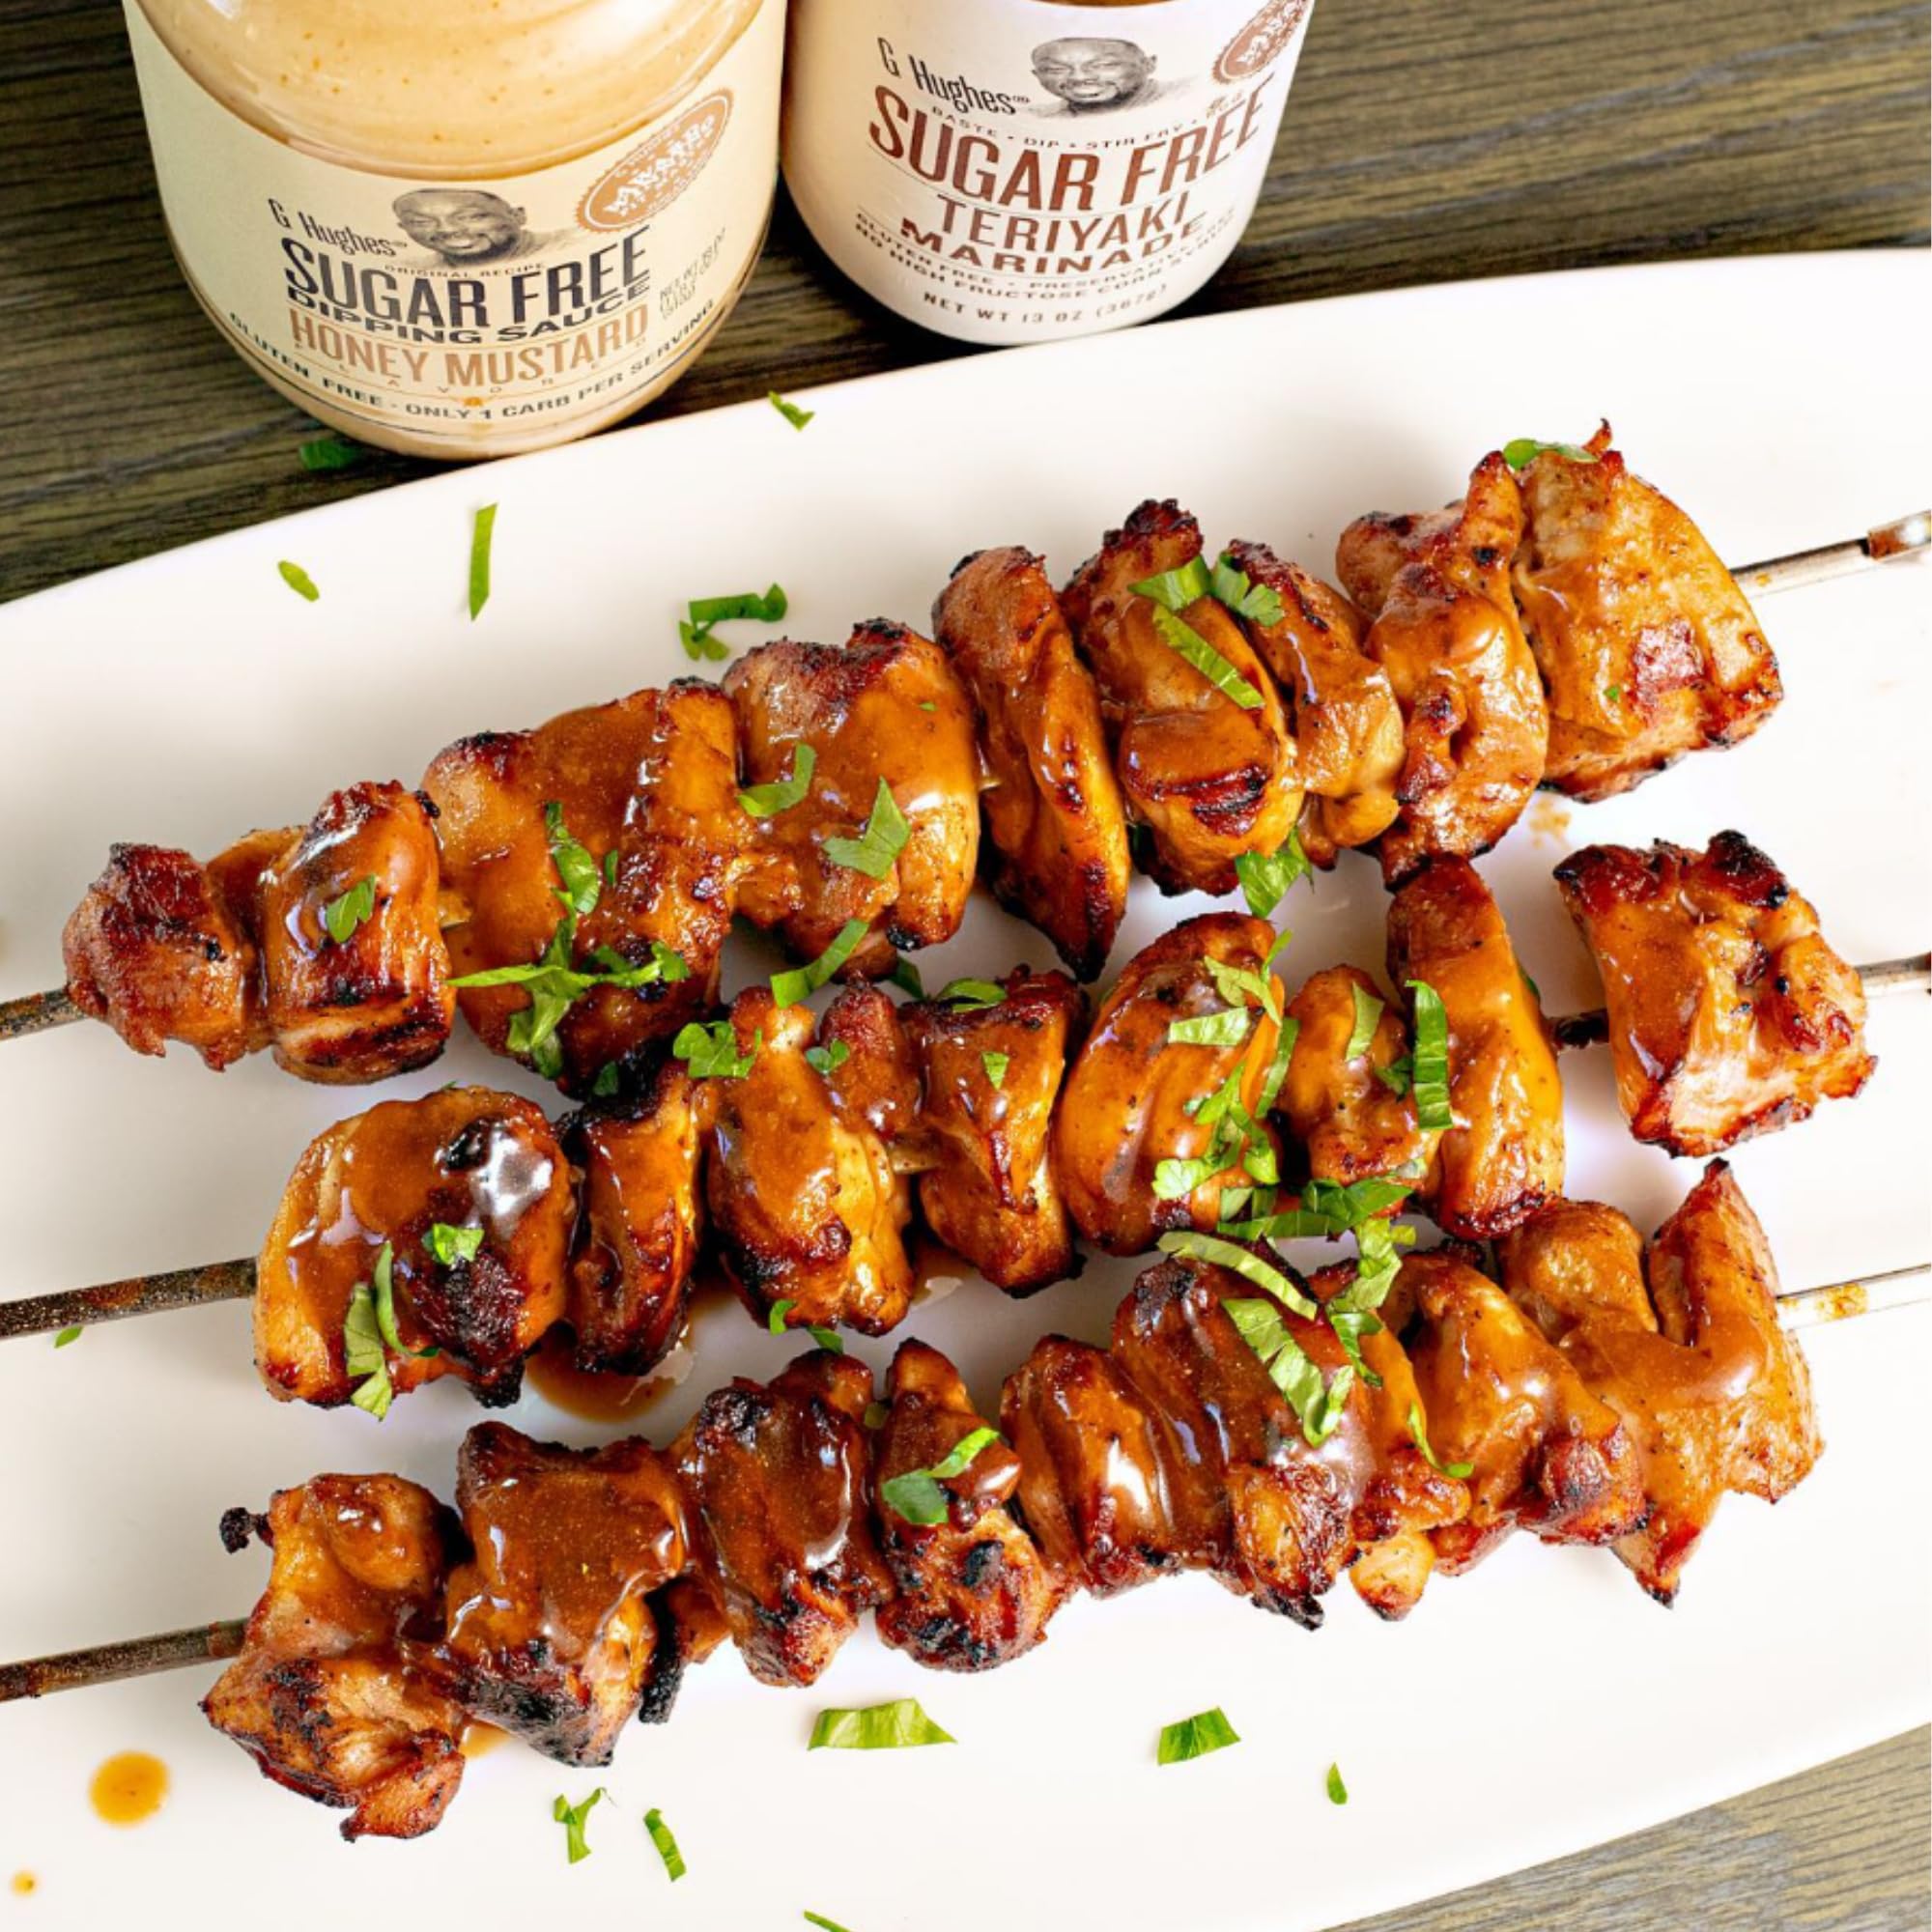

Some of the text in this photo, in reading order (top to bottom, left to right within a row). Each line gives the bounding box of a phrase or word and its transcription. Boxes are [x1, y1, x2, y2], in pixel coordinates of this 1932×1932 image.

[877, 37, 1016, 114] G Hughes
[869, 85, 1100, 212] SUGAR
[1121, 72, 1275, 206] FREE
[269, 198, 397, 257] G Hughes
[900, 211, 1208, 274] MARINADE
[937, 190, 1190, 252] TERIYAKI
[281, 237, 490, 328] SUGAR
[511, 224, 650, 325] FREE
[384, 263, 471, 278] ORIGINAL
[855, 222, 884, 248] NO
[889, 249, 946, 282] HIGH
[953, 279, 1089, 299] FRUCTOSE
[940, 264, 993, 284] FREE
[288, 275, 650, 345] DIPPING SAUCE
[923, 291, 966, 314] NET
[977, 307, 1009, 324] WT
[1021, 312, 1044, 325] 13
[1055, 310, 1083, 324] OZ
[230, 298, 715, 420] GLUTEN FREE ONLY 1 CARB PER SERVING
[290, 304, 648, 387] HONEY MUSTARD
